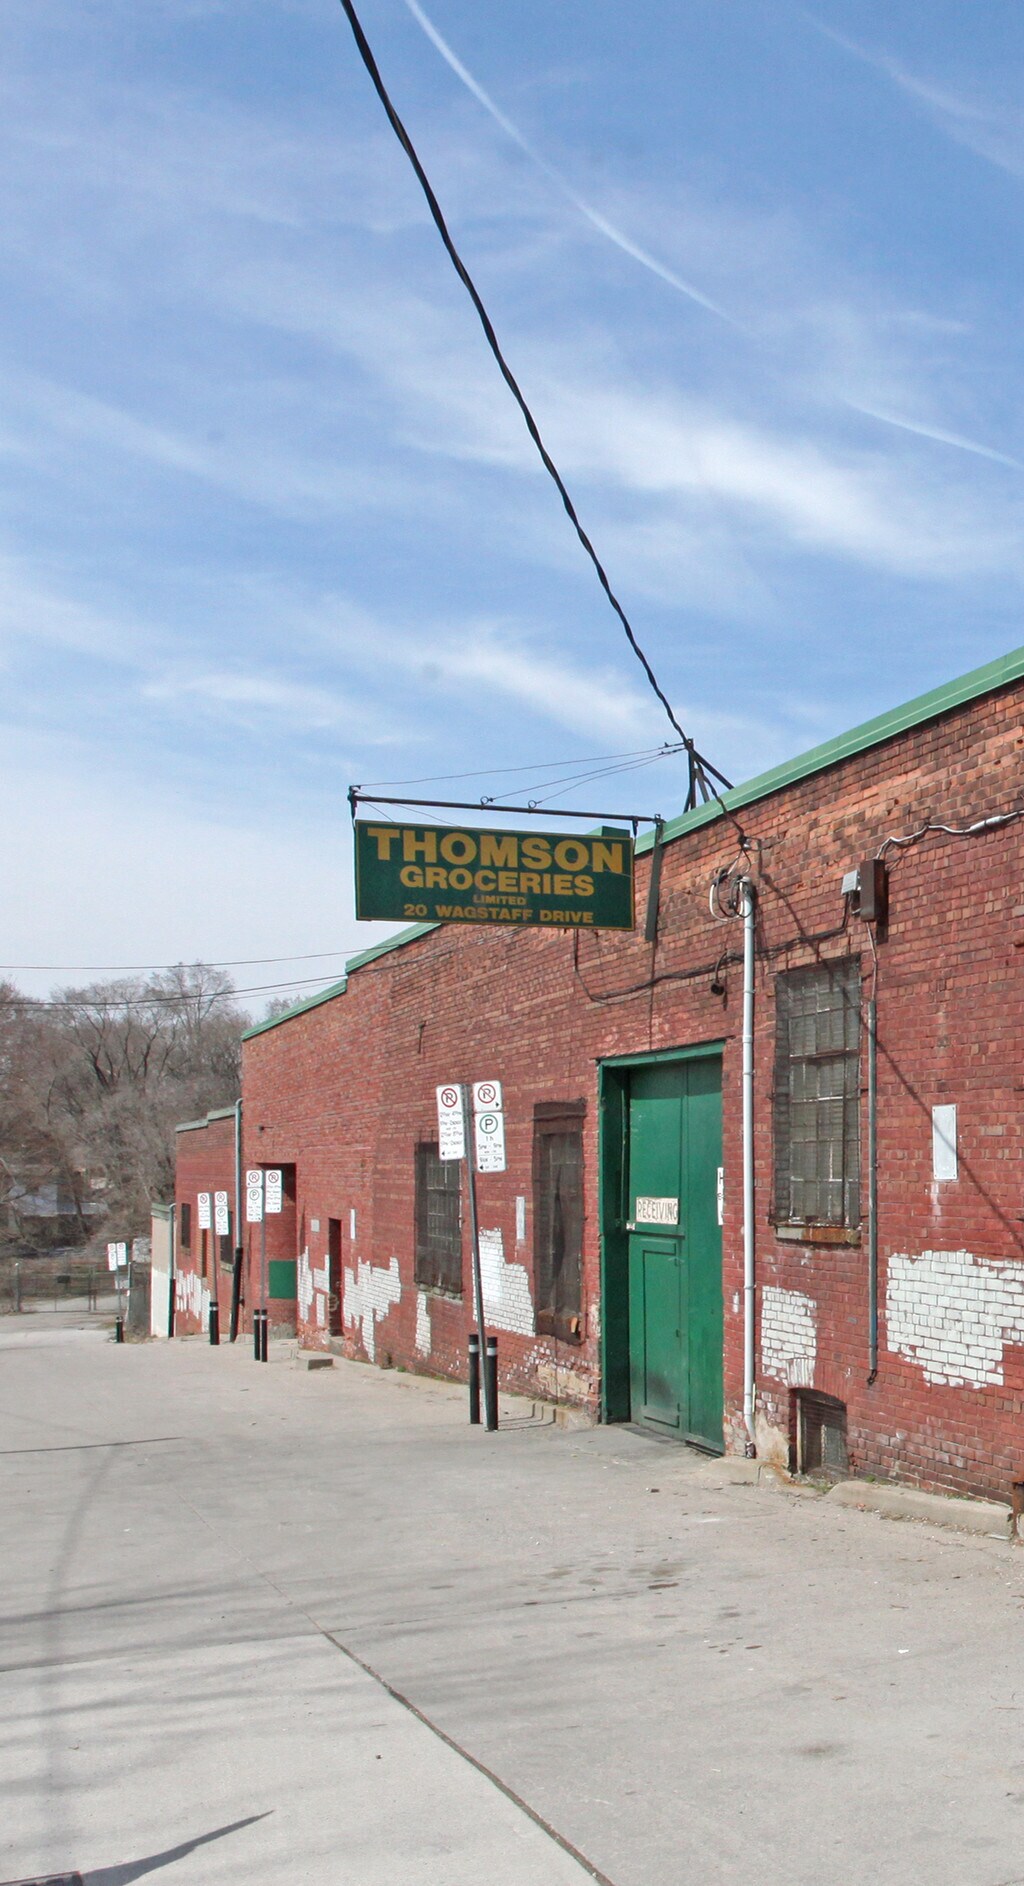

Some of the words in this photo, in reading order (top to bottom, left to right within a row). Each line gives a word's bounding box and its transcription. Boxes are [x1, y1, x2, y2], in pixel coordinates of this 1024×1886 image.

[367, 827, 623, 873] THOMSON
[400, 865, 595, 896] GROCERIES
[473, 894, 526, 906] LIMITED
[403, 903, 427, 917] 20
[435, 905, 533, 920] WAGSTAFF
[540, 909, 594, 924] DRIVE
[485, 1118, 493, 1130] P
